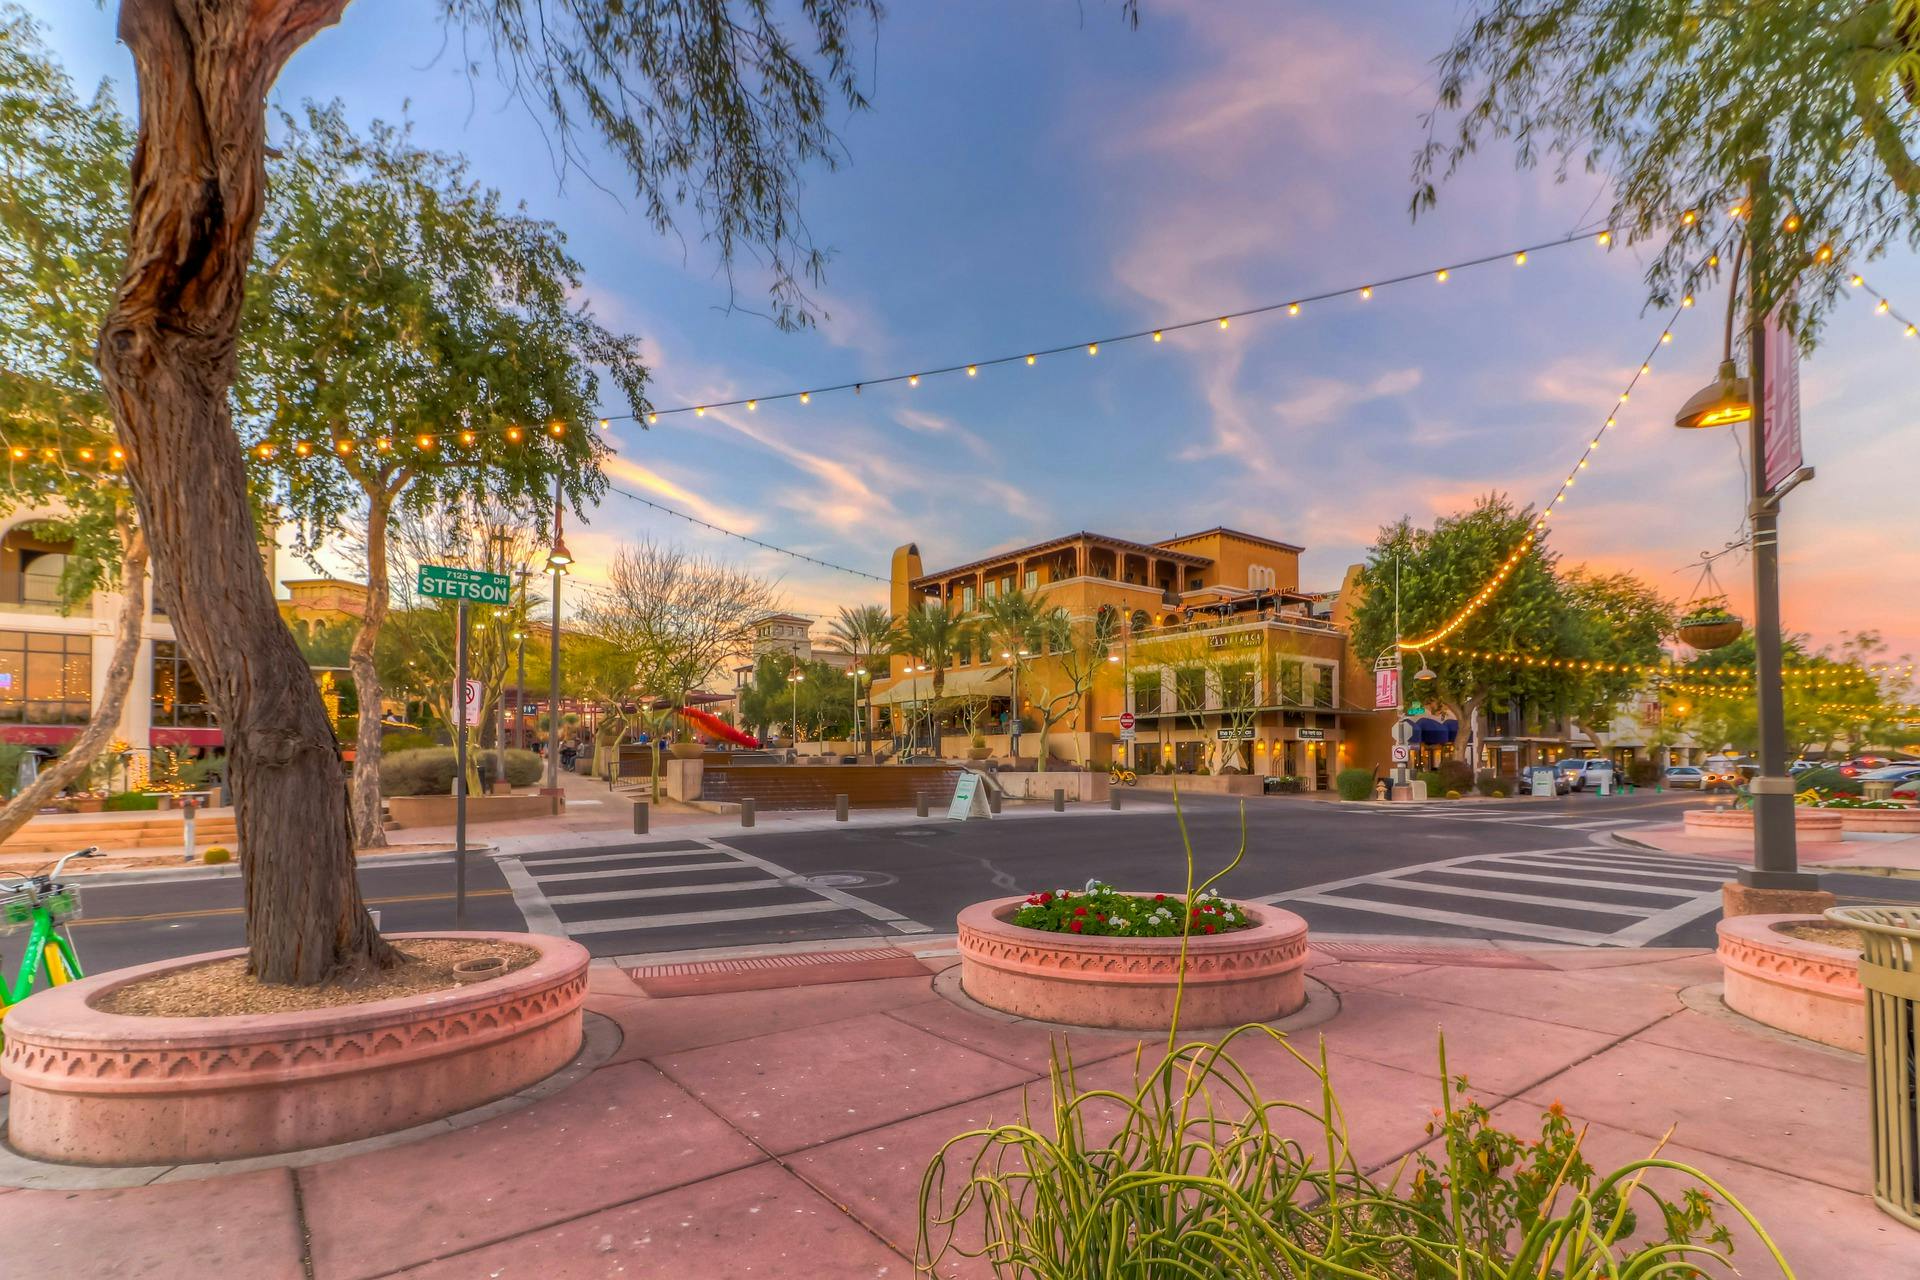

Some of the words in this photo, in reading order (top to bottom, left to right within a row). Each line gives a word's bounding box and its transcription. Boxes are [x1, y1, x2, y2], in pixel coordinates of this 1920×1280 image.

[421, 567, 428, 576] E
[446, 571, 469, 581] 7125
[493, 576, 507, 585] DR
[422, 577, 508, 602] STETSON
